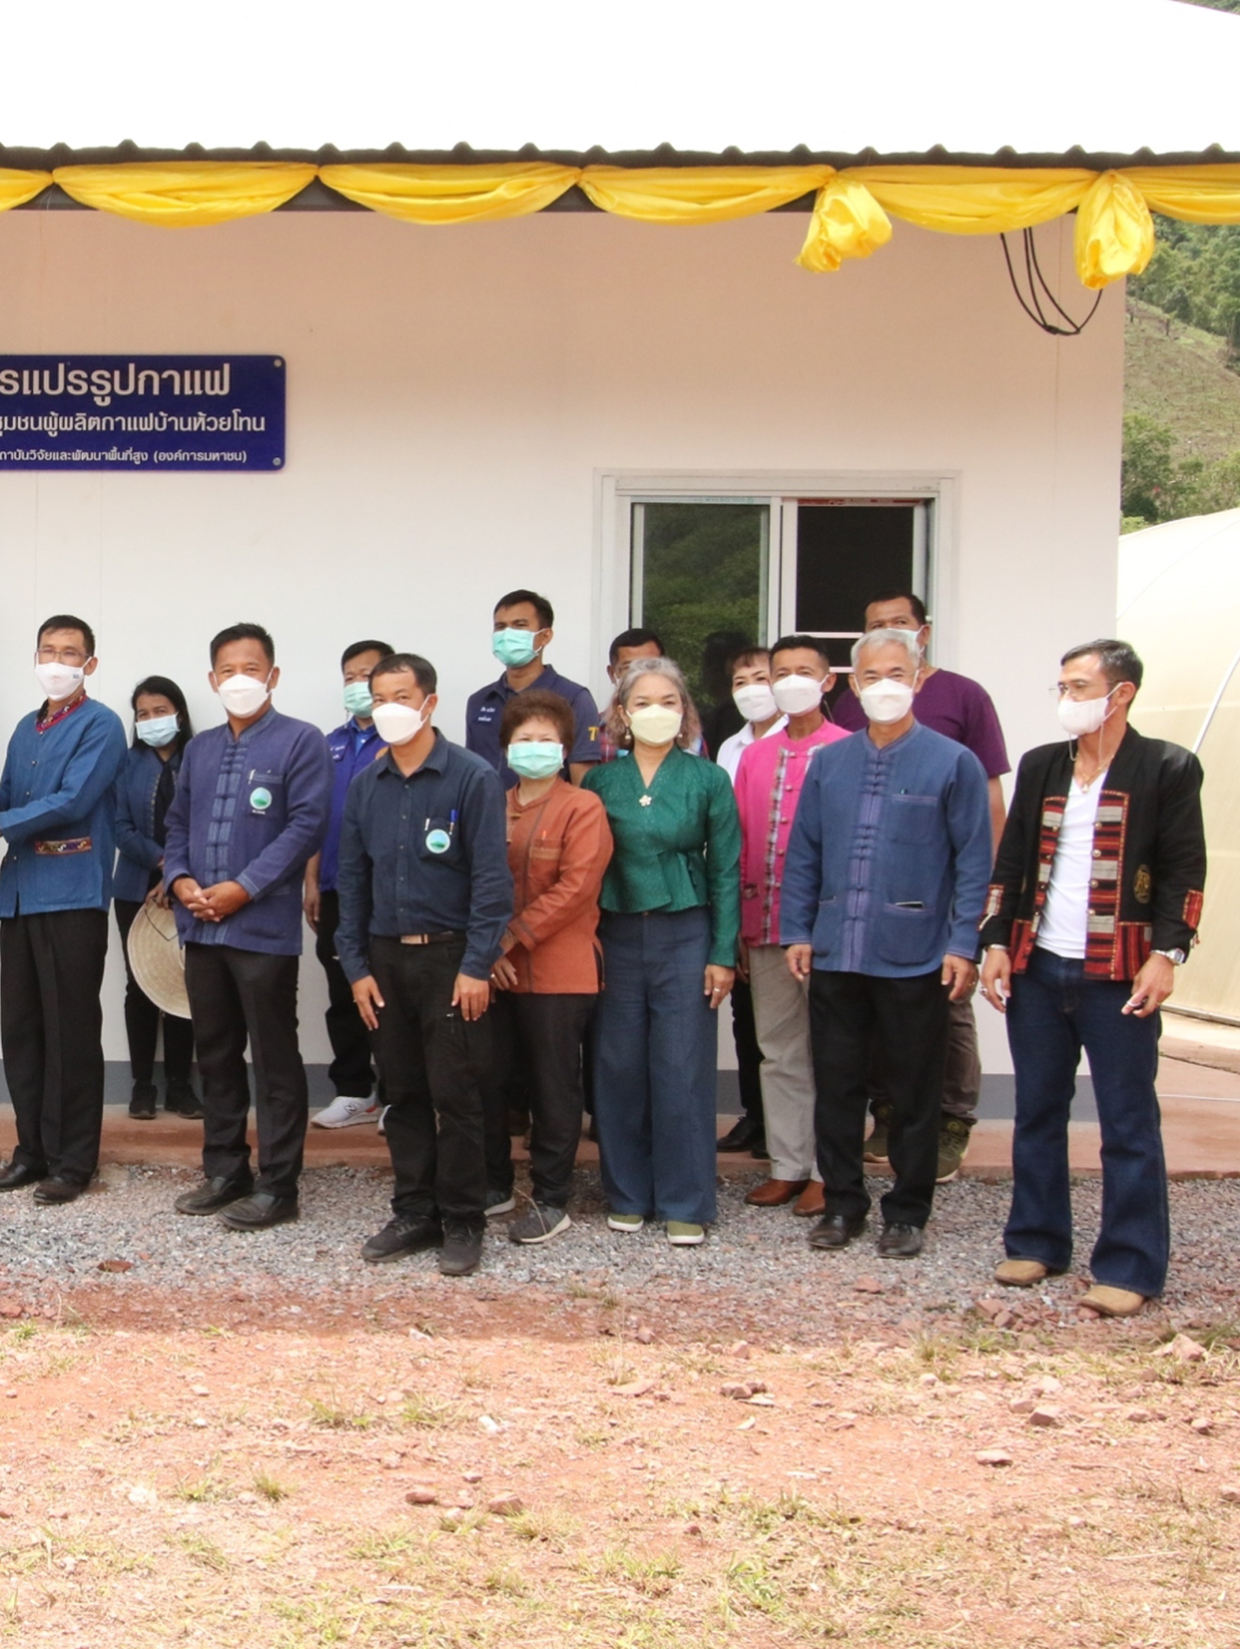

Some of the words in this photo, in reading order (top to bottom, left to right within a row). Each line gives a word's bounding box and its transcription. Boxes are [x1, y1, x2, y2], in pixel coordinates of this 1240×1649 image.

[153, 448, 247, 464] (องค์การมหาชน)
